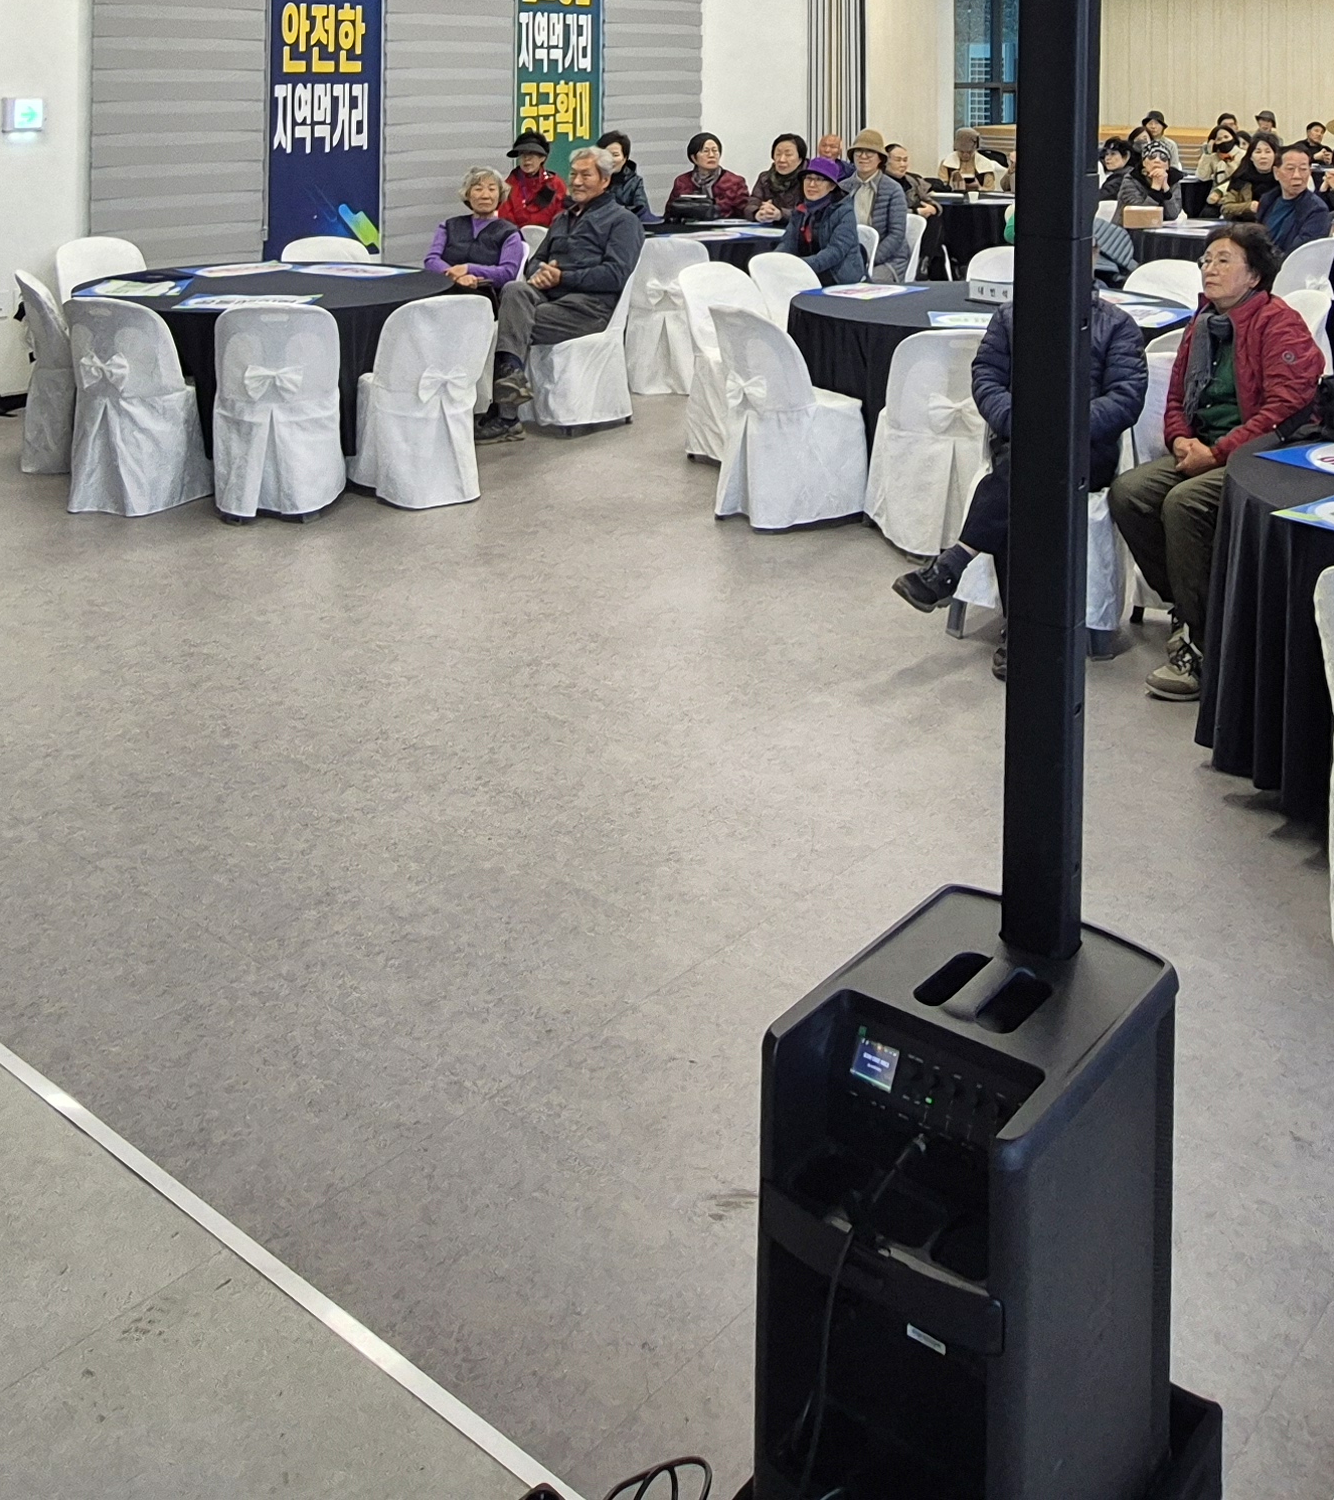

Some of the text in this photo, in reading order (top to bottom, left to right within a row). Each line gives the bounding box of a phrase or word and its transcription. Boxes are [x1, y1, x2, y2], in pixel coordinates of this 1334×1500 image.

[281, 2, 366, 74] 안전한
[518, 11, 593, 73] 지역먹거리
[273, 82, 369, 154] 지역먹거리
[520, 80, 591, 142] 공급확대
